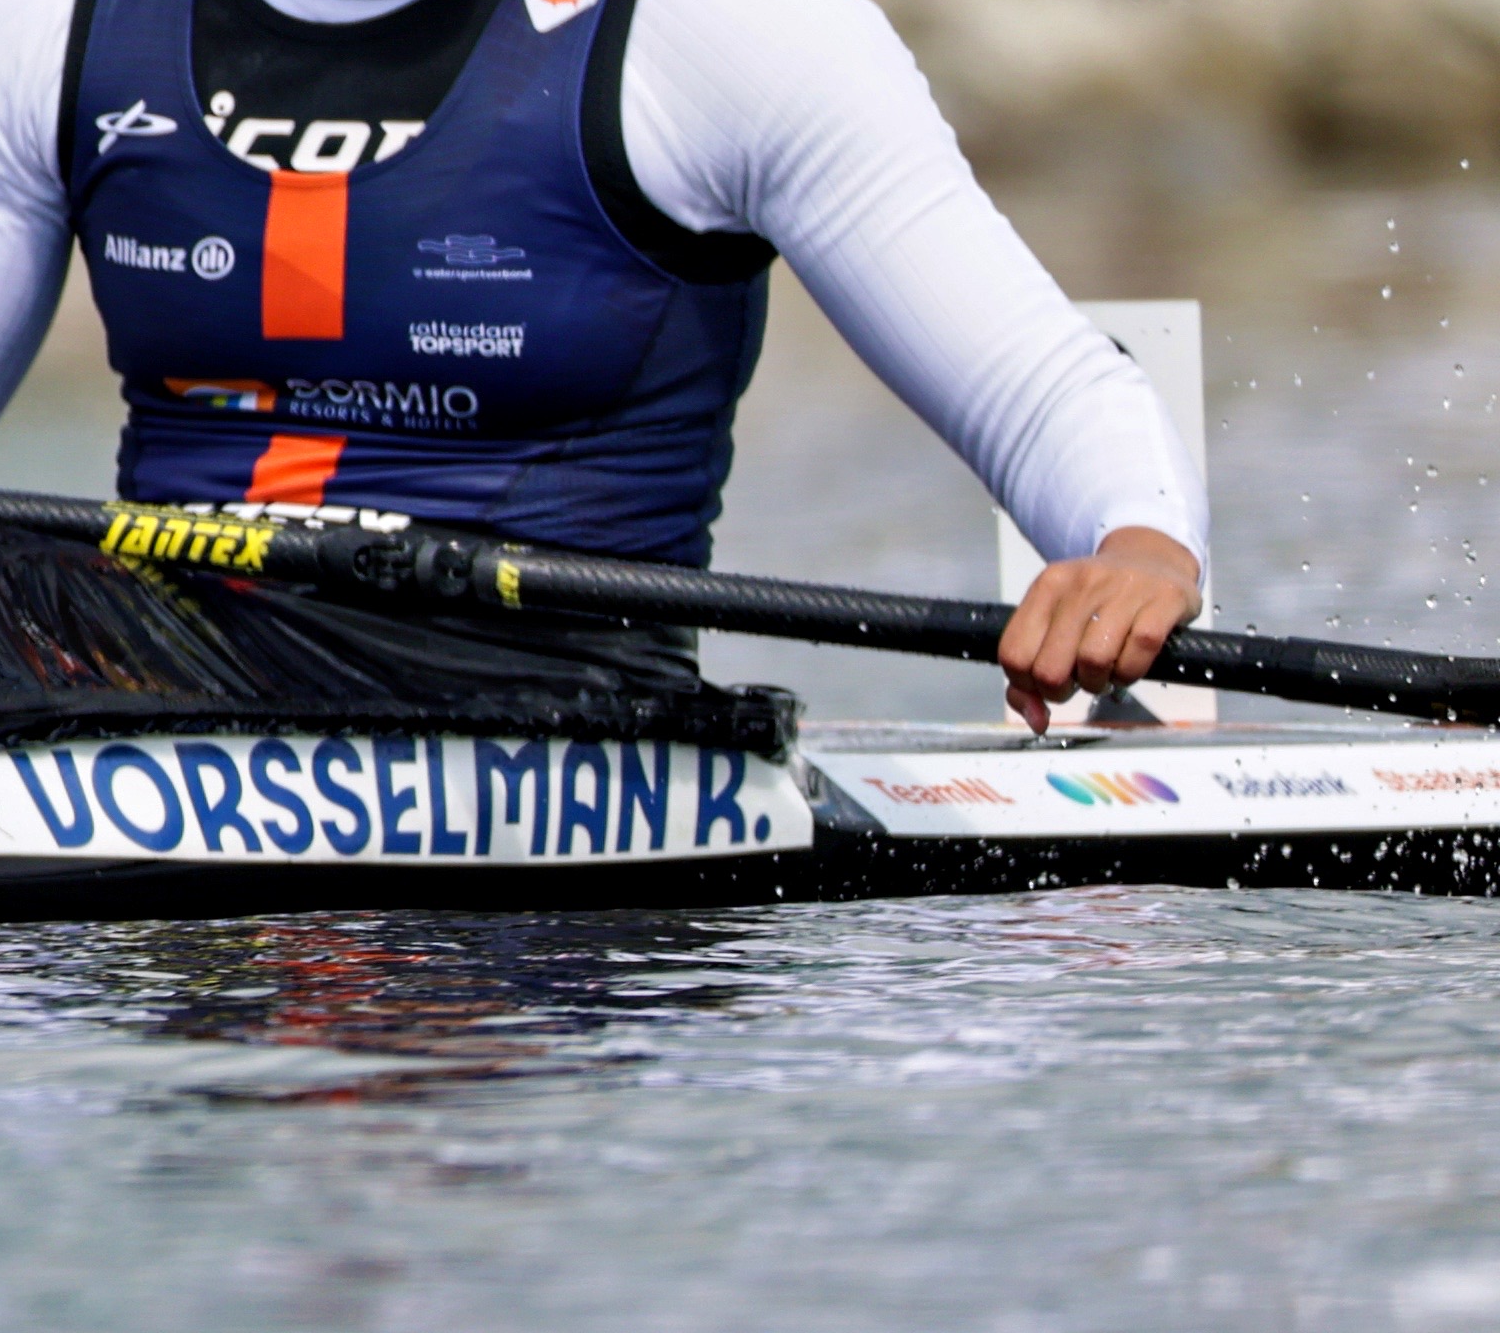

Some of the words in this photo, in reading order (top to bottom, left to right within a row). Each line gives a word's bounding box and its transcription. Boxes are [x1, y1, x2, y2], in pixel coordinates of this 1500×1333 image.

[104, 232, 187, 272] Allianz
[409, 319, 525, 339] rotterdam
[410, 334, 524, 358] TOPSPORT
[9, 736, 673, 856] VORSSELMAN
[860, 776, 1017, 805] TeamNL
